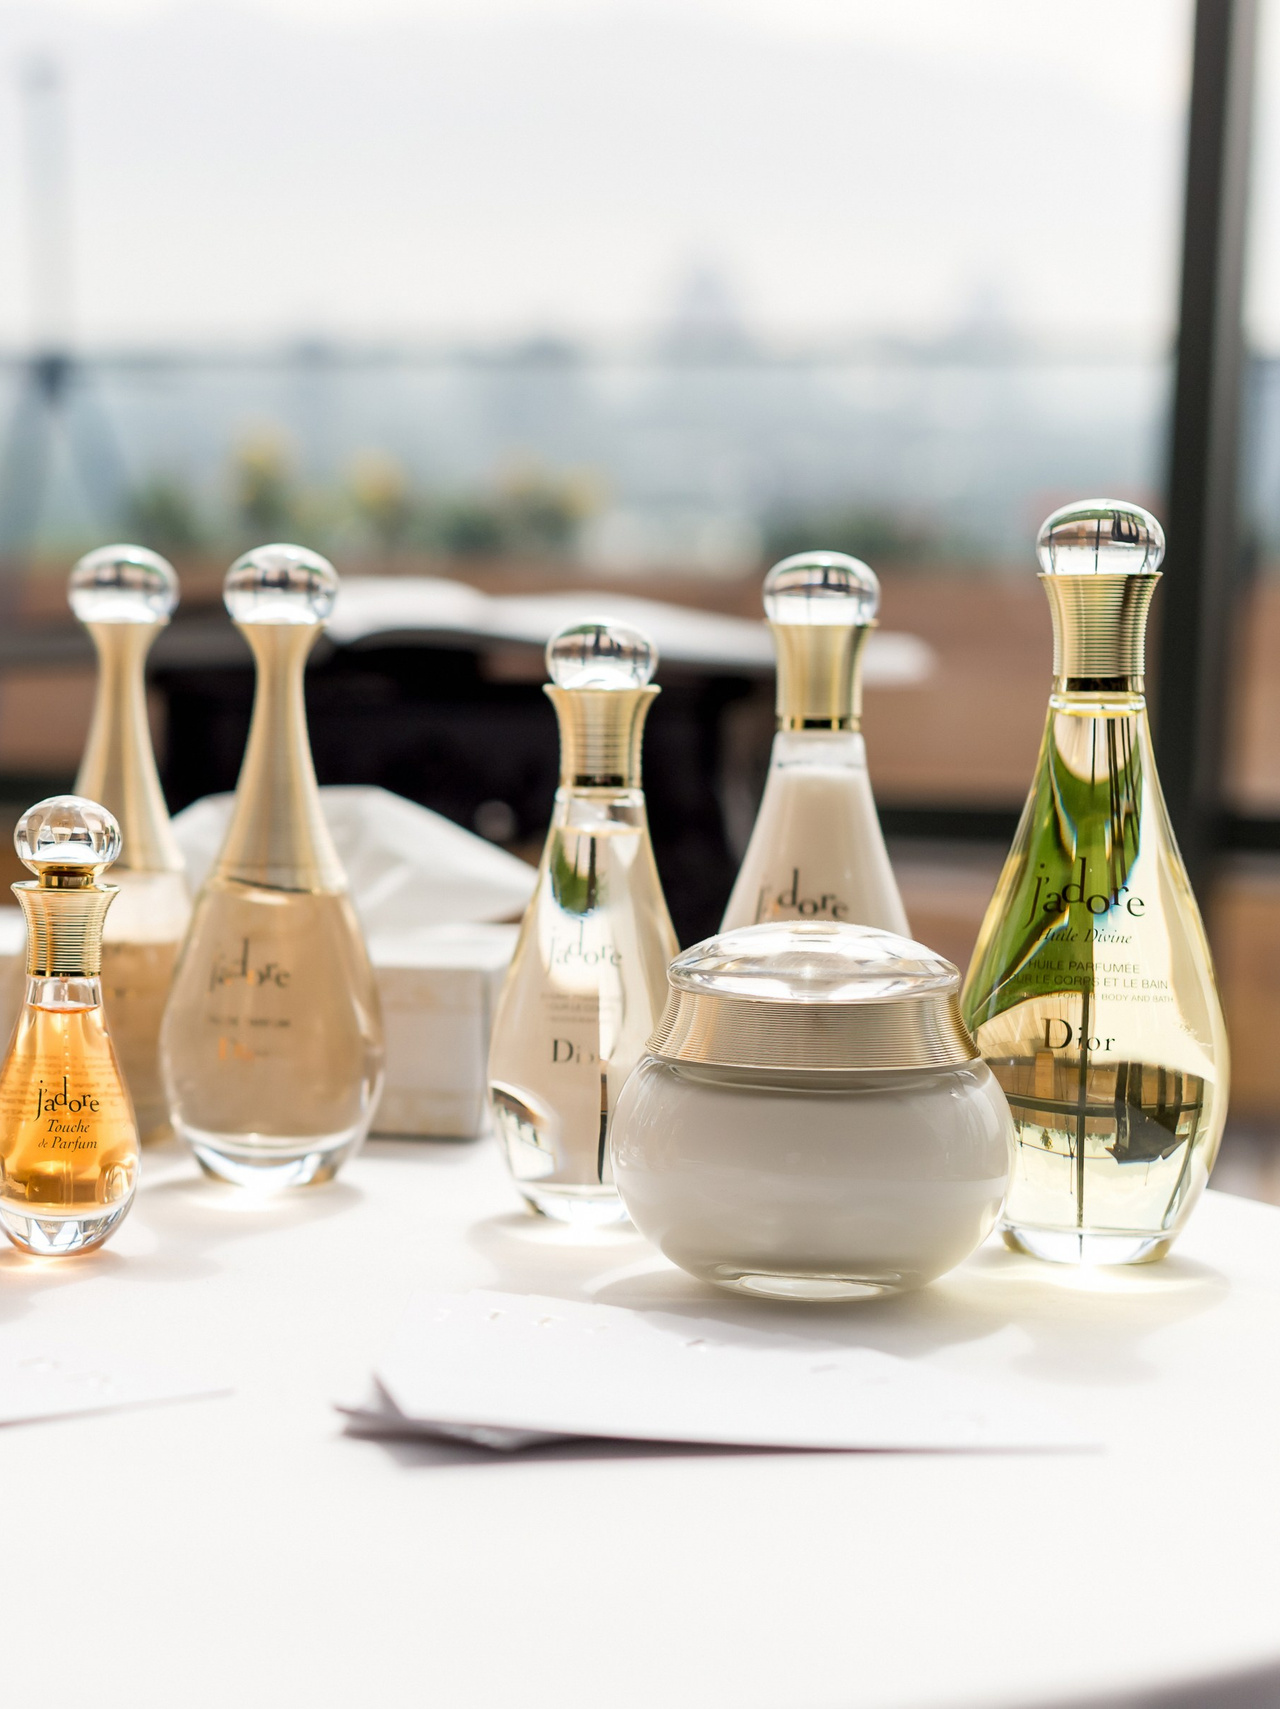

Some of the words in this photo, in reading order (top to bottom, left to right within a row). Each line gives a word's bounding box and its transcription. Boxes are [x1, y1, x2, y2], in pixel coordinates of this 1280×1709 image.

[1023, 857, 1146, 929] j'adore
[1084, 928, 1132, 944] Divine
[1068, 960, 1140, 974] PARFUMÉE
[1141, 979, 1168, 990] BAIN
[1041, 1017, 1116, 1052] Dior
[33, 1076, 100, 1122] j'adore
[46, 1119, 90, 1133] Touche
[37, 1138, 48, 1149] de
[51, 1136, 97, 1153] Parfum
